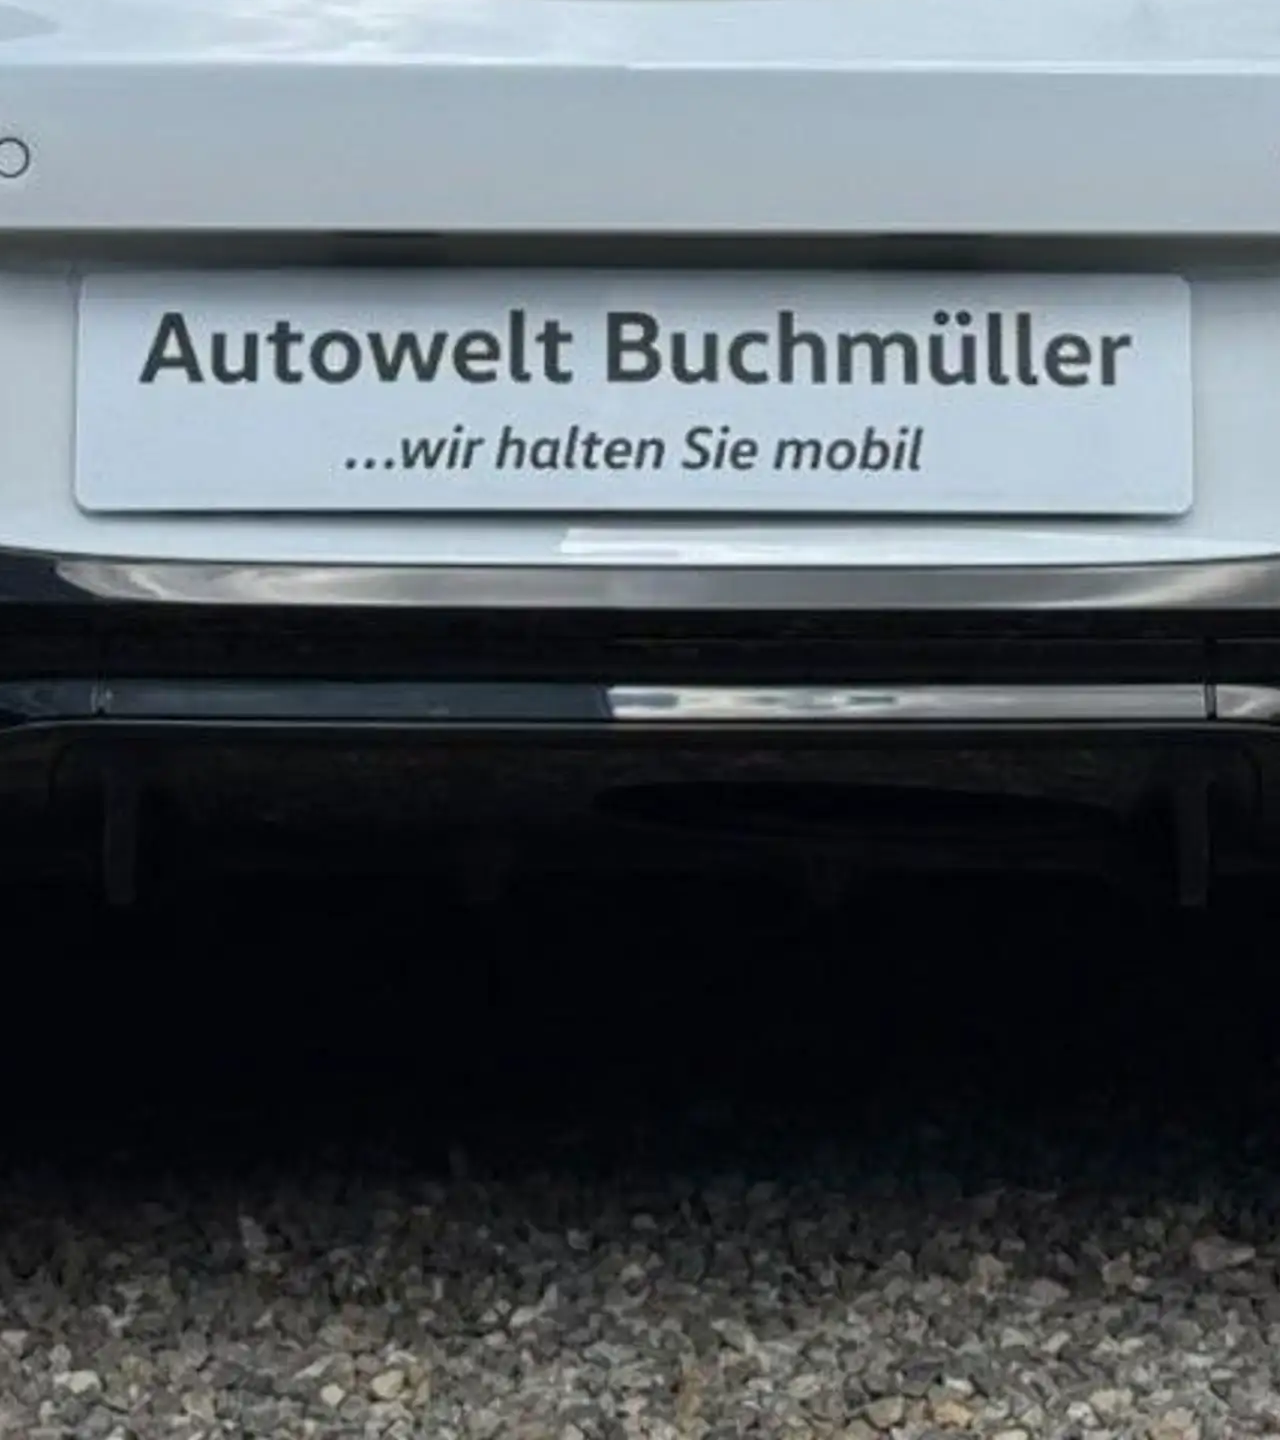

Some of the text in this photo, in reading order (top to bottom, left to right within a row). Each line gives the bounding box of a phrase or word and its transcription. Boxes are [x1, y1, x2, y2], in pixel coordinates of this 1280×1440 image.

[138, 308, 1133, 387] Autowelt Buchmüller
[495, 425, 666, 471] halten
[681, 425, 759, 471] Sie
[773, 426, 924, 472] mobil
